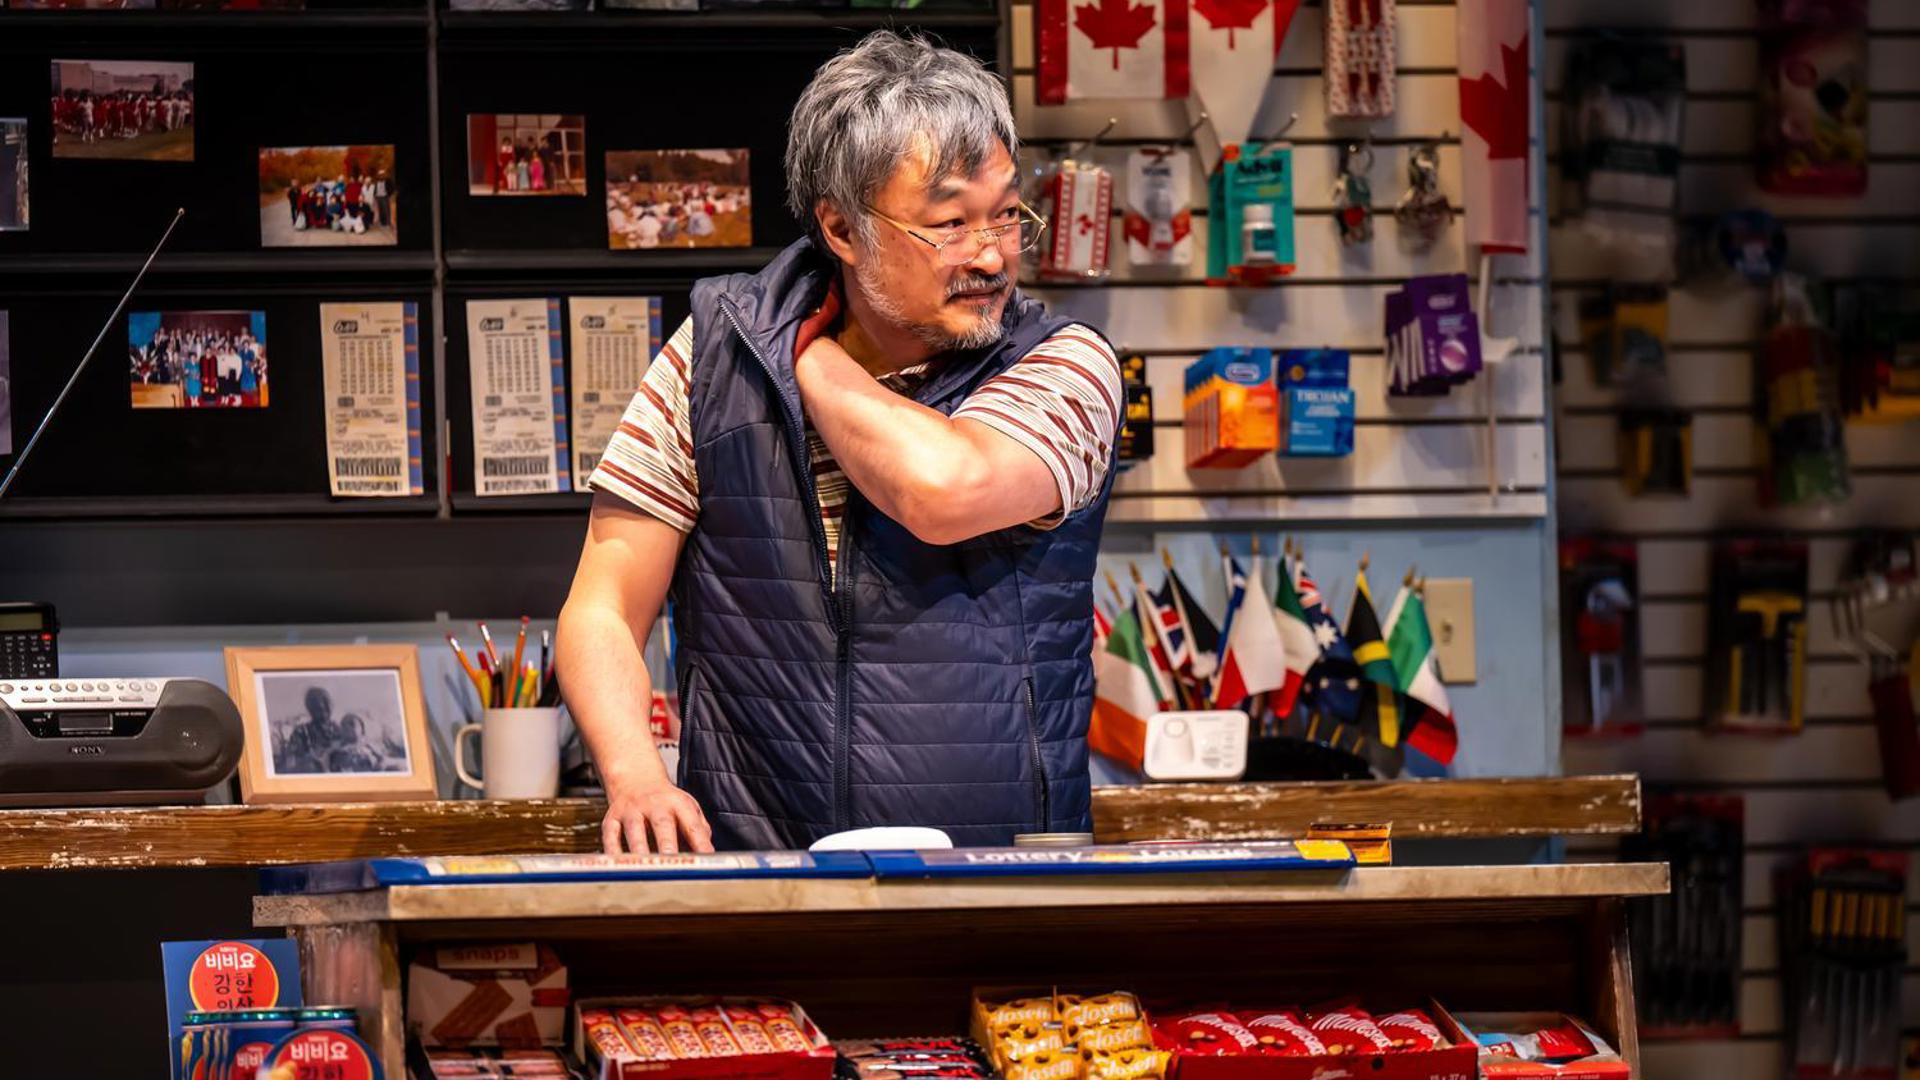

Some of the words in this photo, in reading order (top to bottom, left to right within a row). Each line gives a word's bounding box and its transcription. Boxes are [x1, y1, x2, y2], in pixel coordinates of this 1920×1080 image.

[1297, 389, 1349, 403] TROJAN
[614, 855, 695, 865] MILLION
[965, 851, 1084, 863] Lottery
[205, 952, 256, 970] 비비요
[1311, 1013, 1393, 1047] Maltesers
[290, 1042, 349, 1062] 비비요
